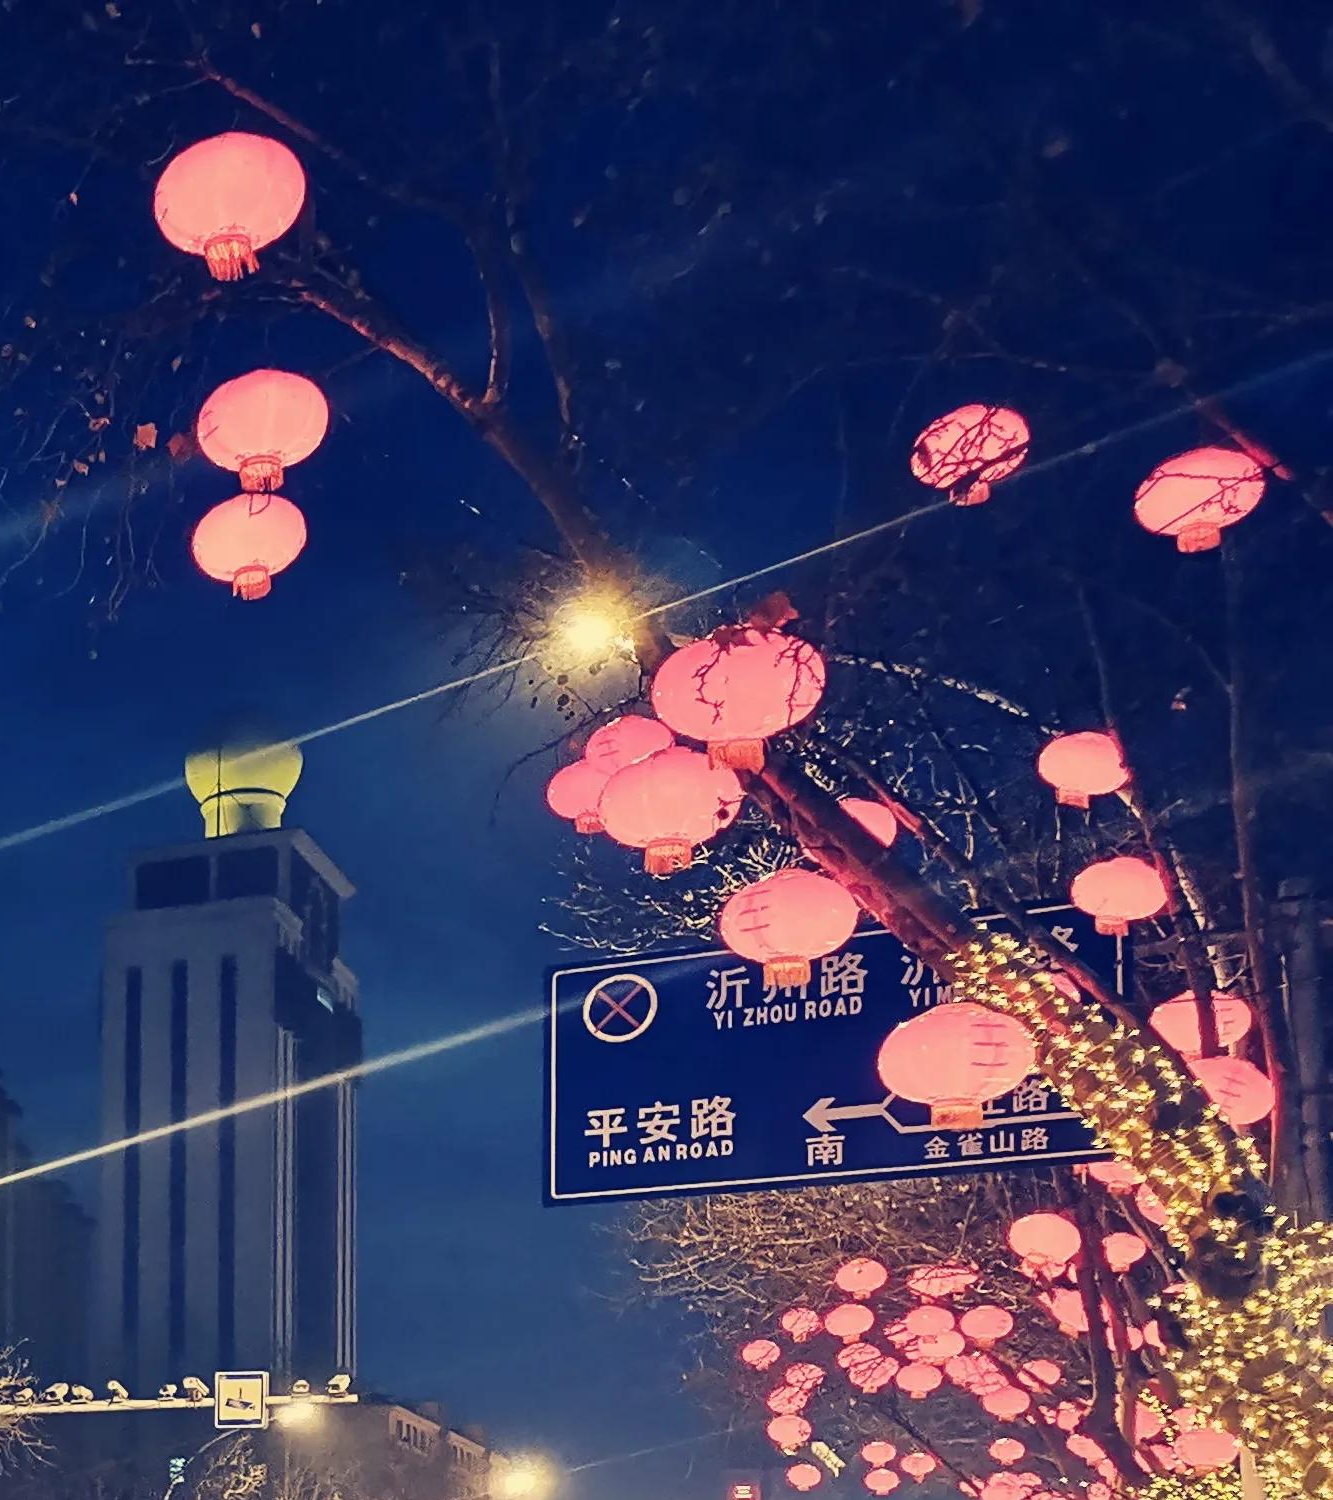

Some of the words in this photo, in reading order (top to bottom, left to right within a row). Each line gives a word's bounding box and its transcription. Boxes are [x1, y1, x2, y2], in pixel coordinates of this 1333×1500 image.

[713, 1010, 733, 1030] YI
[743, 1003, 797, 1027] ZHOU
[804, 996, 863, 1020] ROAD
[584, 1095, 736, 1148] 平安路
[589, 1148, 637, 1168] PING
[642, 1145, 670, 1163] AN
[675, 1140, 733, 1161] ROAD
[806, 1133, 845, 1166] 南
[924, 1127, 1049, 1159] 金雀山路
